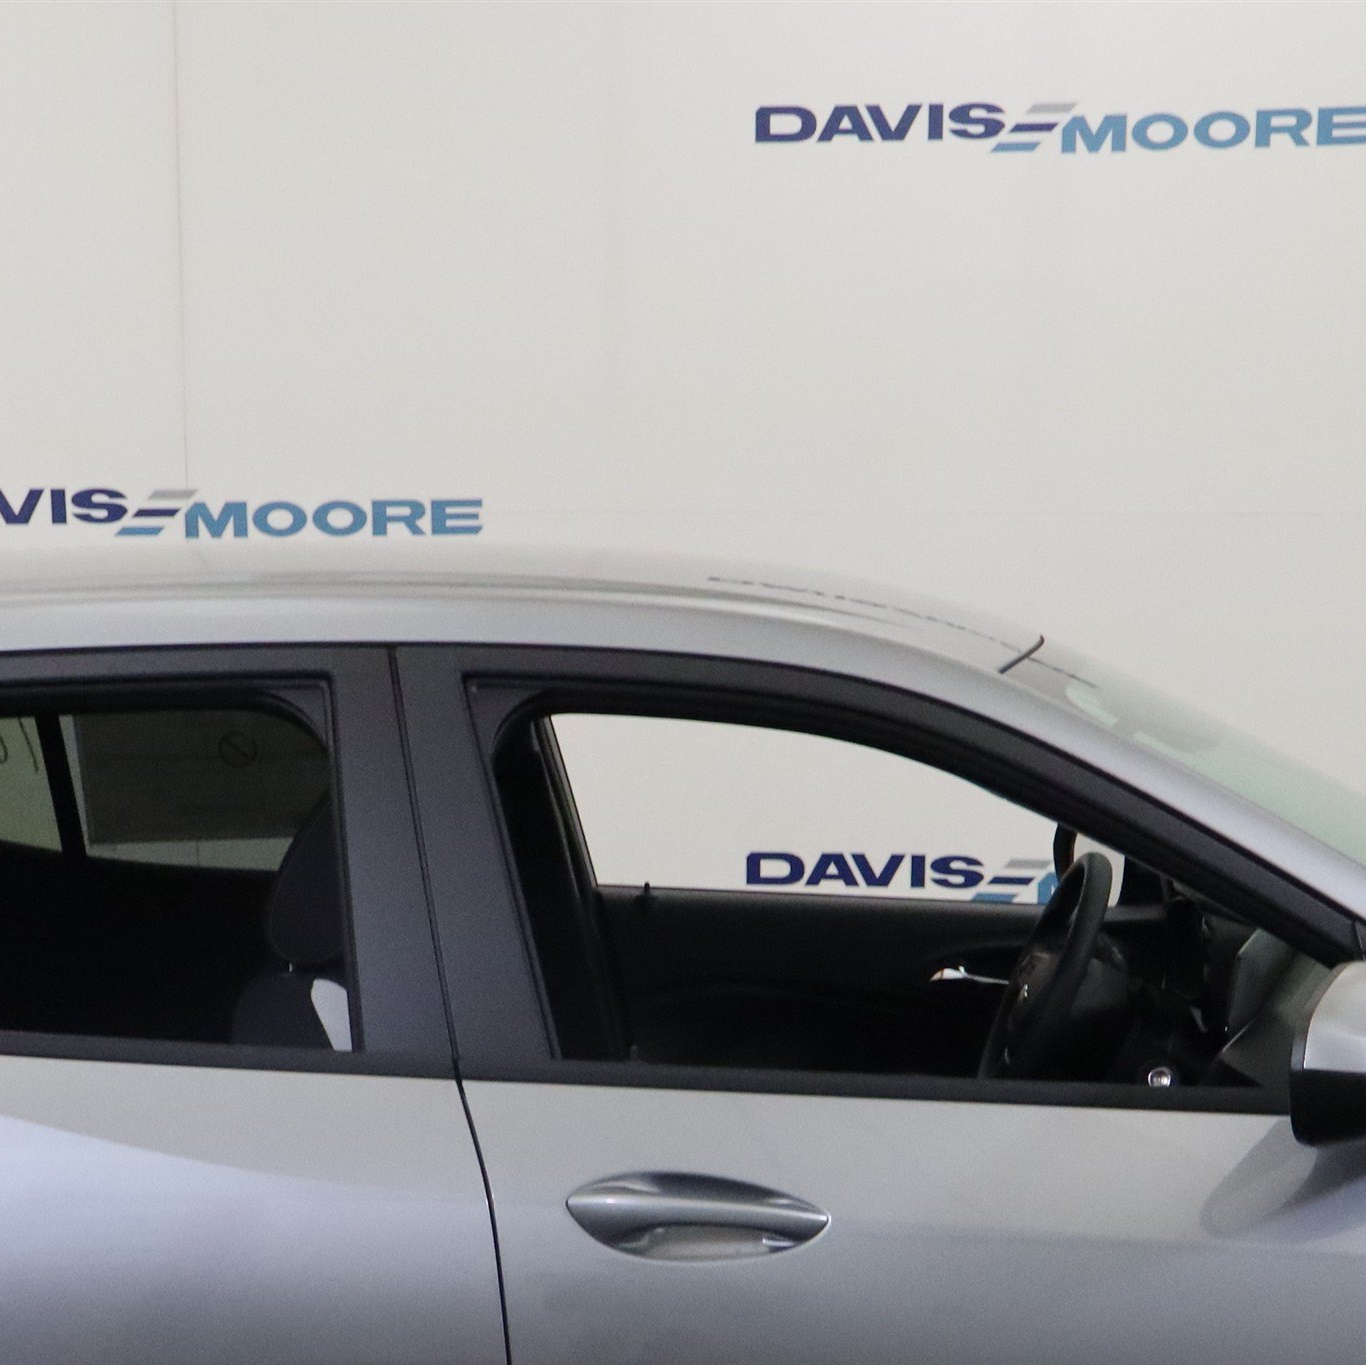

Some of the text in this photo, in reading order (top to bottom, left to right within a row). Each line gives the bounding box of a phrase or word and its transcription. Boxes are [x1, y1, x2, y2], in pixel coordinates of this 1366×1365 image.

[754, 102, 1006, 144] DAVIS
[184, 498, 484, 540] MOORE
[745, 852, 983, 890] DAVIS
